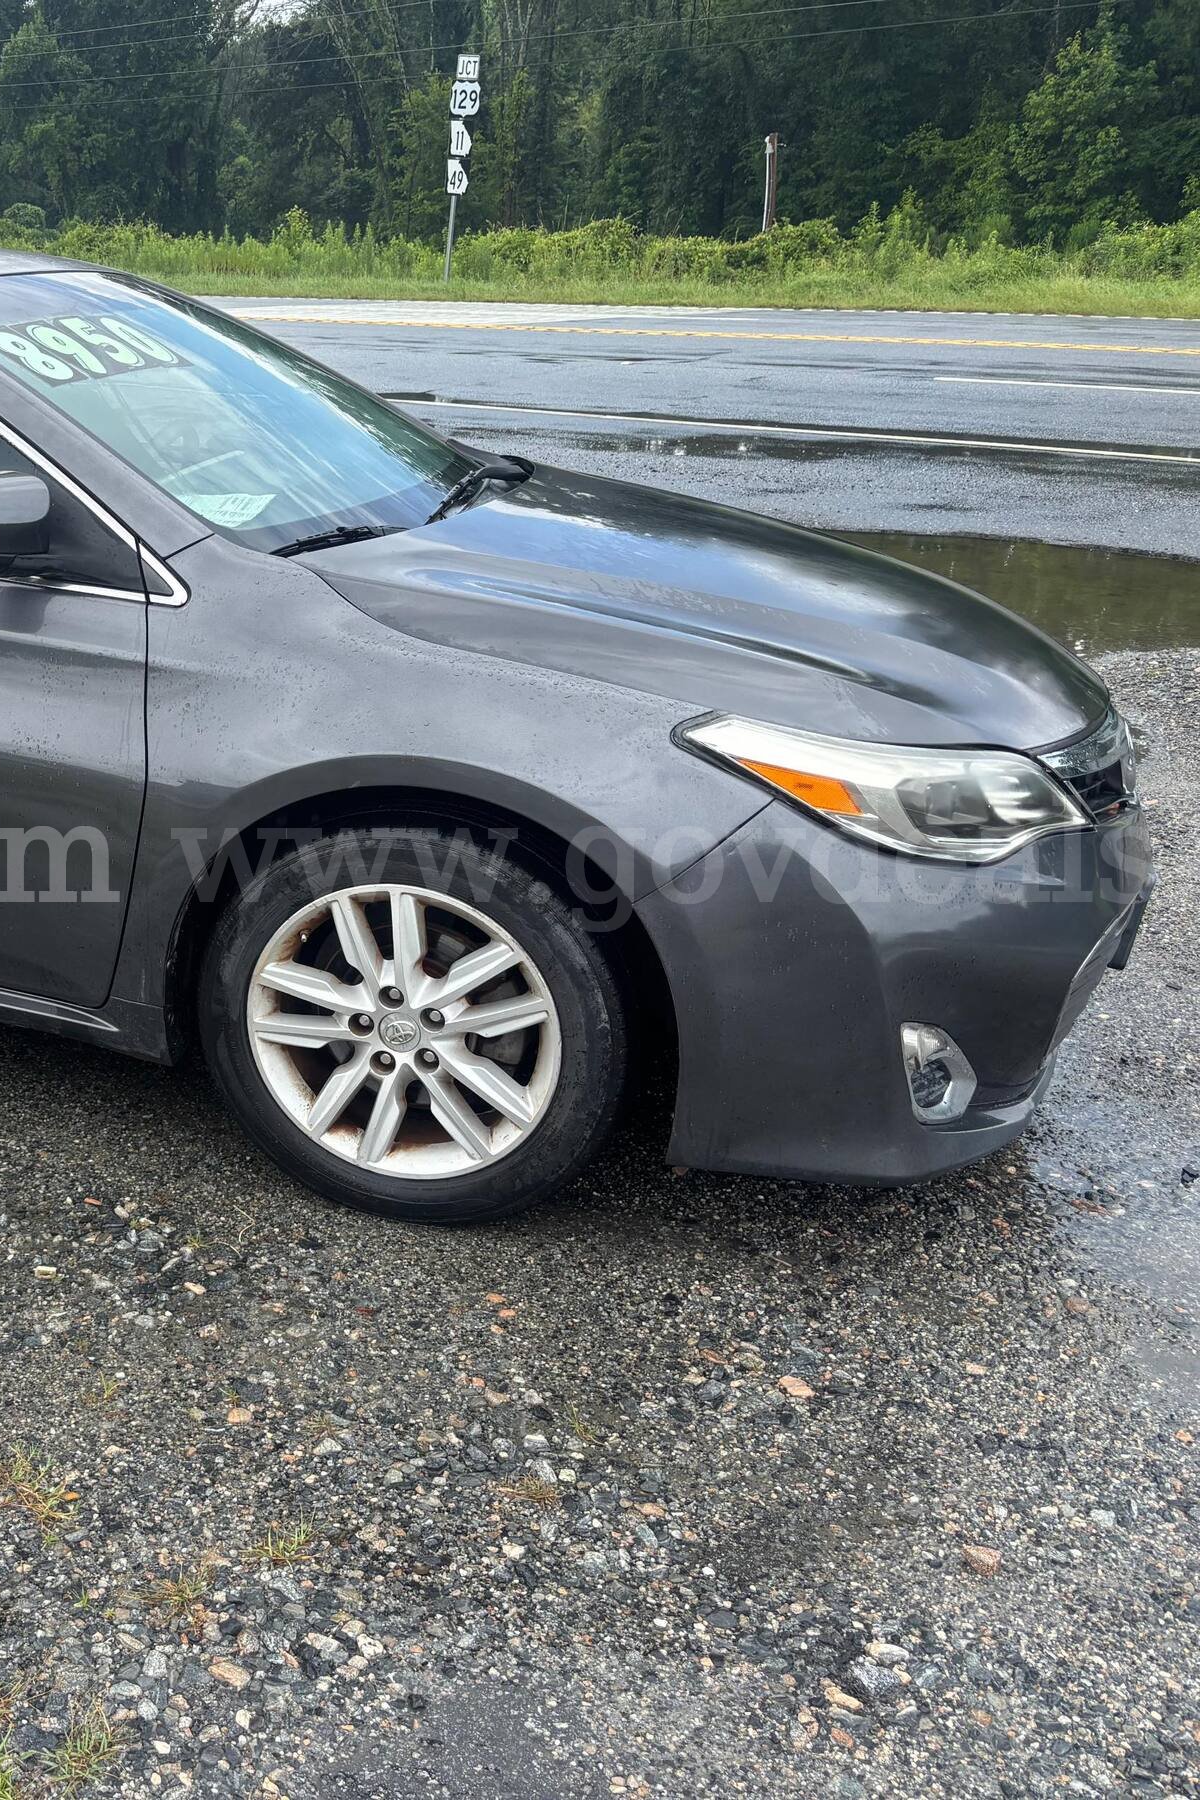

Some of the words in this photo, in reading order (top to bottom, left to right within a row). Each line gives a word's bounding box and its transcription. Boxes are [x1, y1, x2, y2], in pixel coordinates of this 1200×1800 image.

[458, 60, 478, 76] JCT
[452, 88, 478, 109] 129
[455, 130, 465, 151] 11
[449, 170, 464, 190] 49
